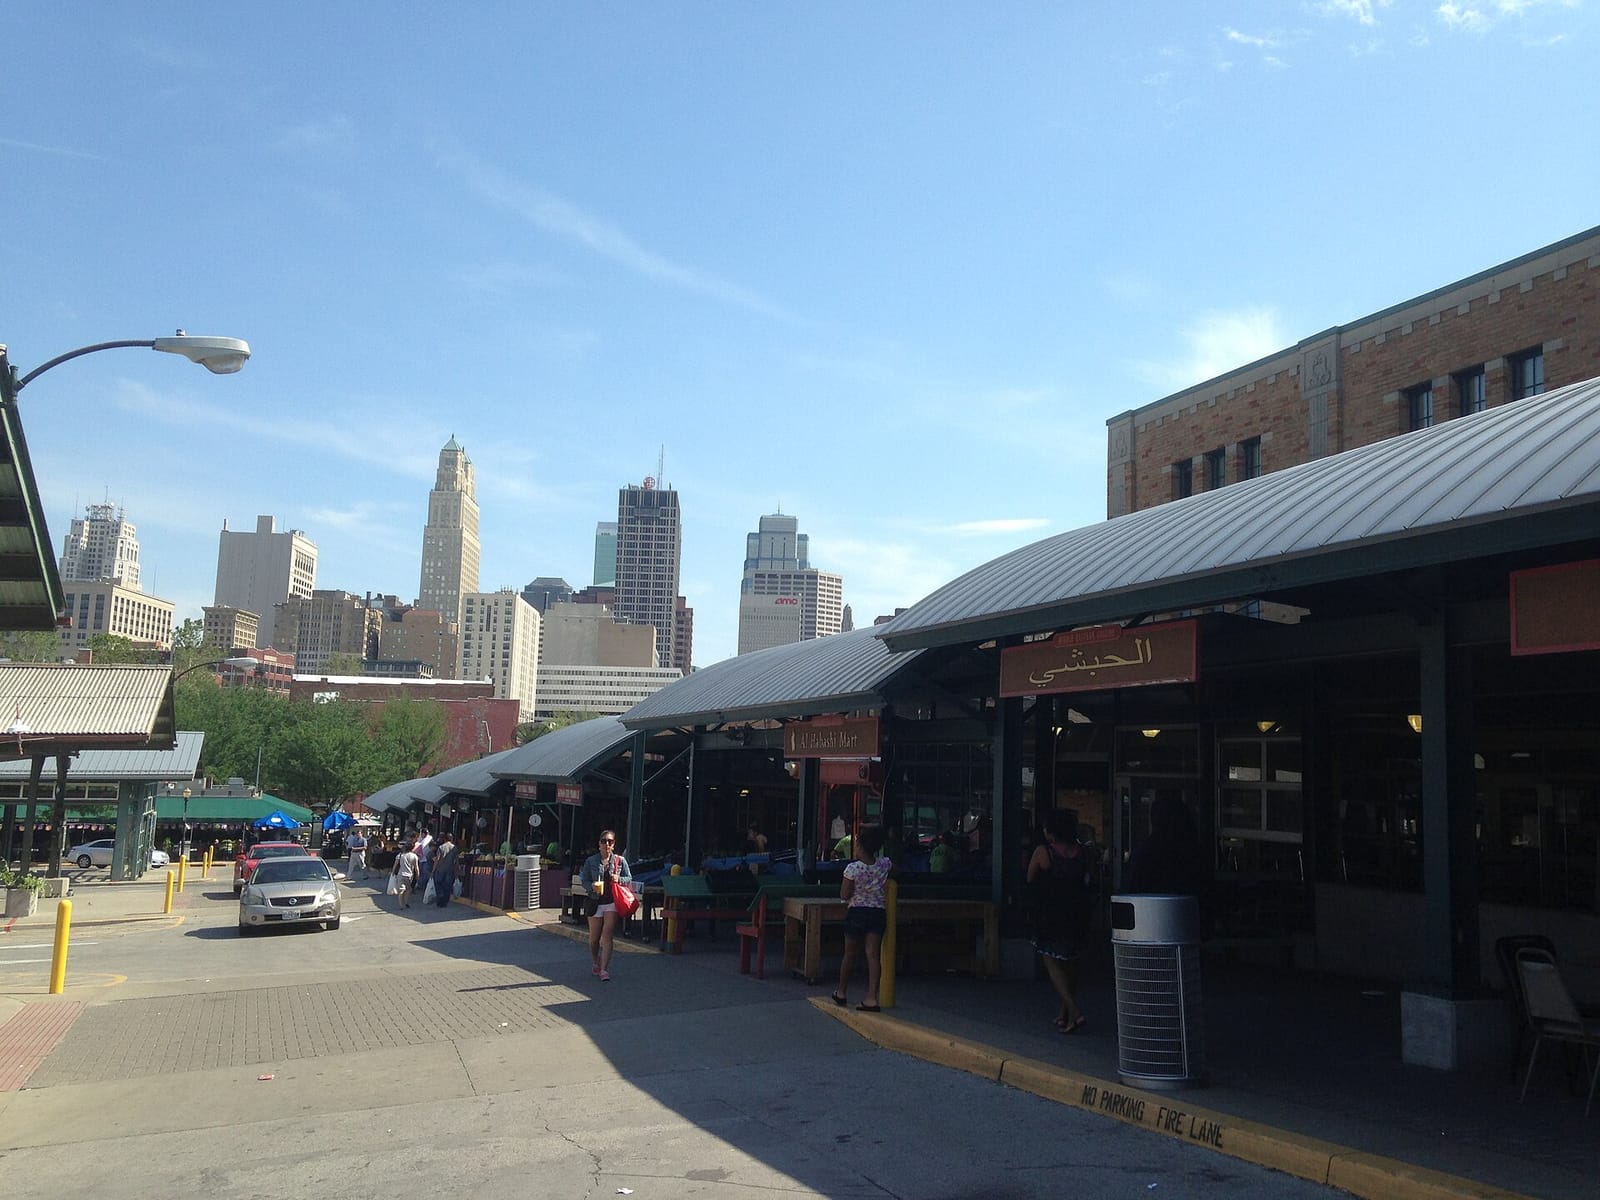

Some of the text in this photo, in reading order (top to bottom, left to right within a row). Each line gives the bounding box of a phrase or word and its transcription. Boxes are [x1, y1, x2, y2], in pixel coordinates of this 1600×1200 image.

[775, 597, 798, 606] amc
[1029, 637, 1153, 688] الحبشي
[839, 731, 858, 749] Mart
[1081, 1085, 1224, 1148] NO PARKING FIRE LANE
